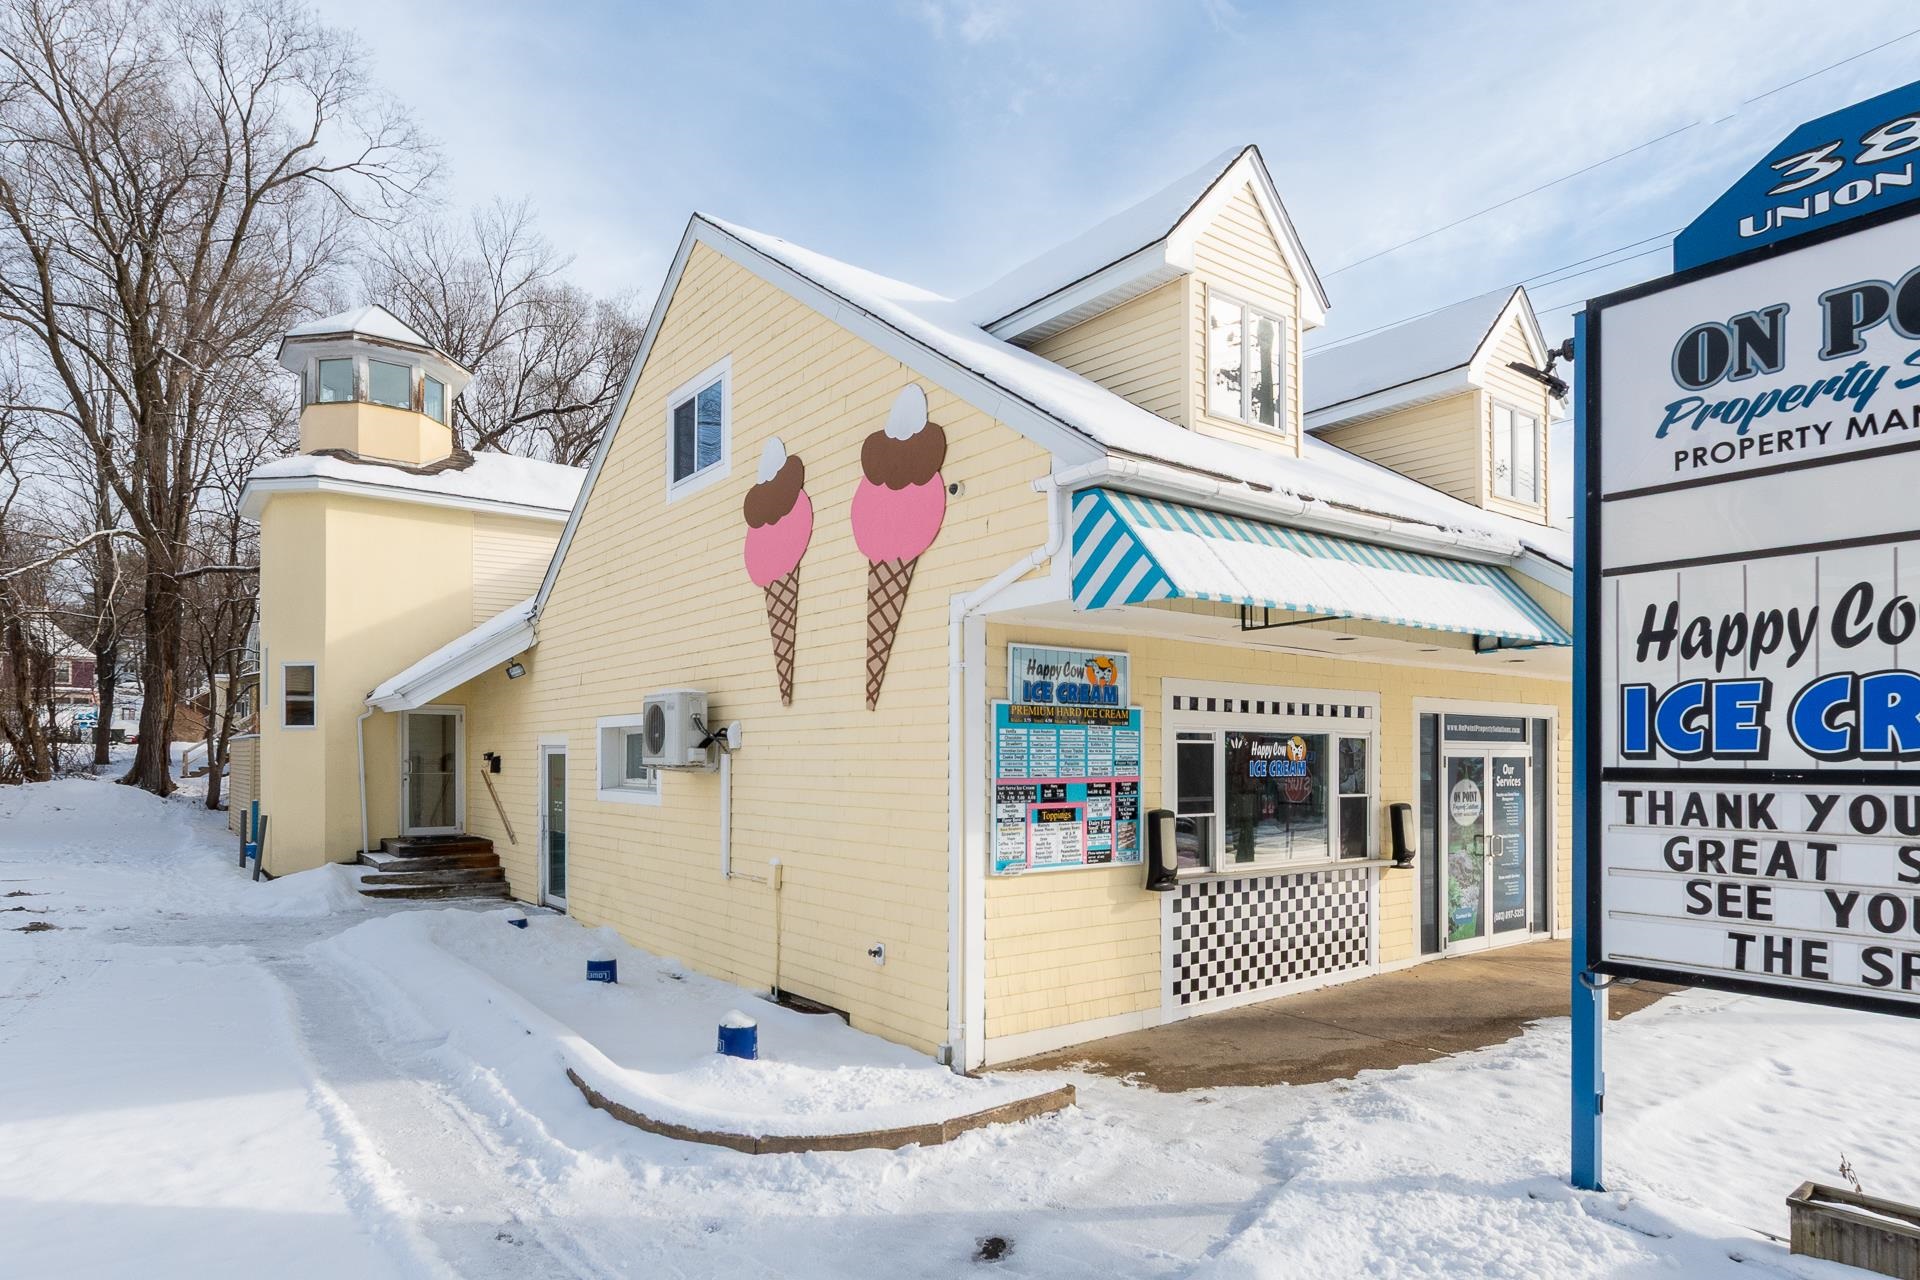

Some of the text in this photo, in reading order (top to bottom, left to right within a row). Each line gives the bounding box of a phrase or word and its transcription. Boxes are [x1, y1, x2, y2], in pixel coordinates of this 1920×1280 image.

[1738, 162, 1914, 238] UNION
[1671, 303, 1790, 391] ON
[1655, 360, 1890, 439] Property
[1674, 404, 1920, 472] PROPERTY MA
[1636, 600, 1819, 673] Happy
[1026, 658, 1085, 680] Happy Cow
[1011, 705, 1128, 719] PREMIUM HARD ICE CREAM
[1023, 679, 1119, 705] ICE CREAM
[1620, 677, 1773, 761] ICE
[1249, 760, 1307, 778] ICE CREAM
[1251, 741, 1287, 759] Happy Cow
[1502, 763, 1515, 775] Our
[1454, 791, 1477, 802] ON POINT
[1496, 775, 1521, 787] Services
[1042, 811, 1071, 822] Toppings
[1617, 790, 1920, 836] THANK YOU
[1663, 836, 1838, 881] GREAT
[1685, 879, 1920, 935] SEE YO
[1728, 931, 1829, 980] THE
